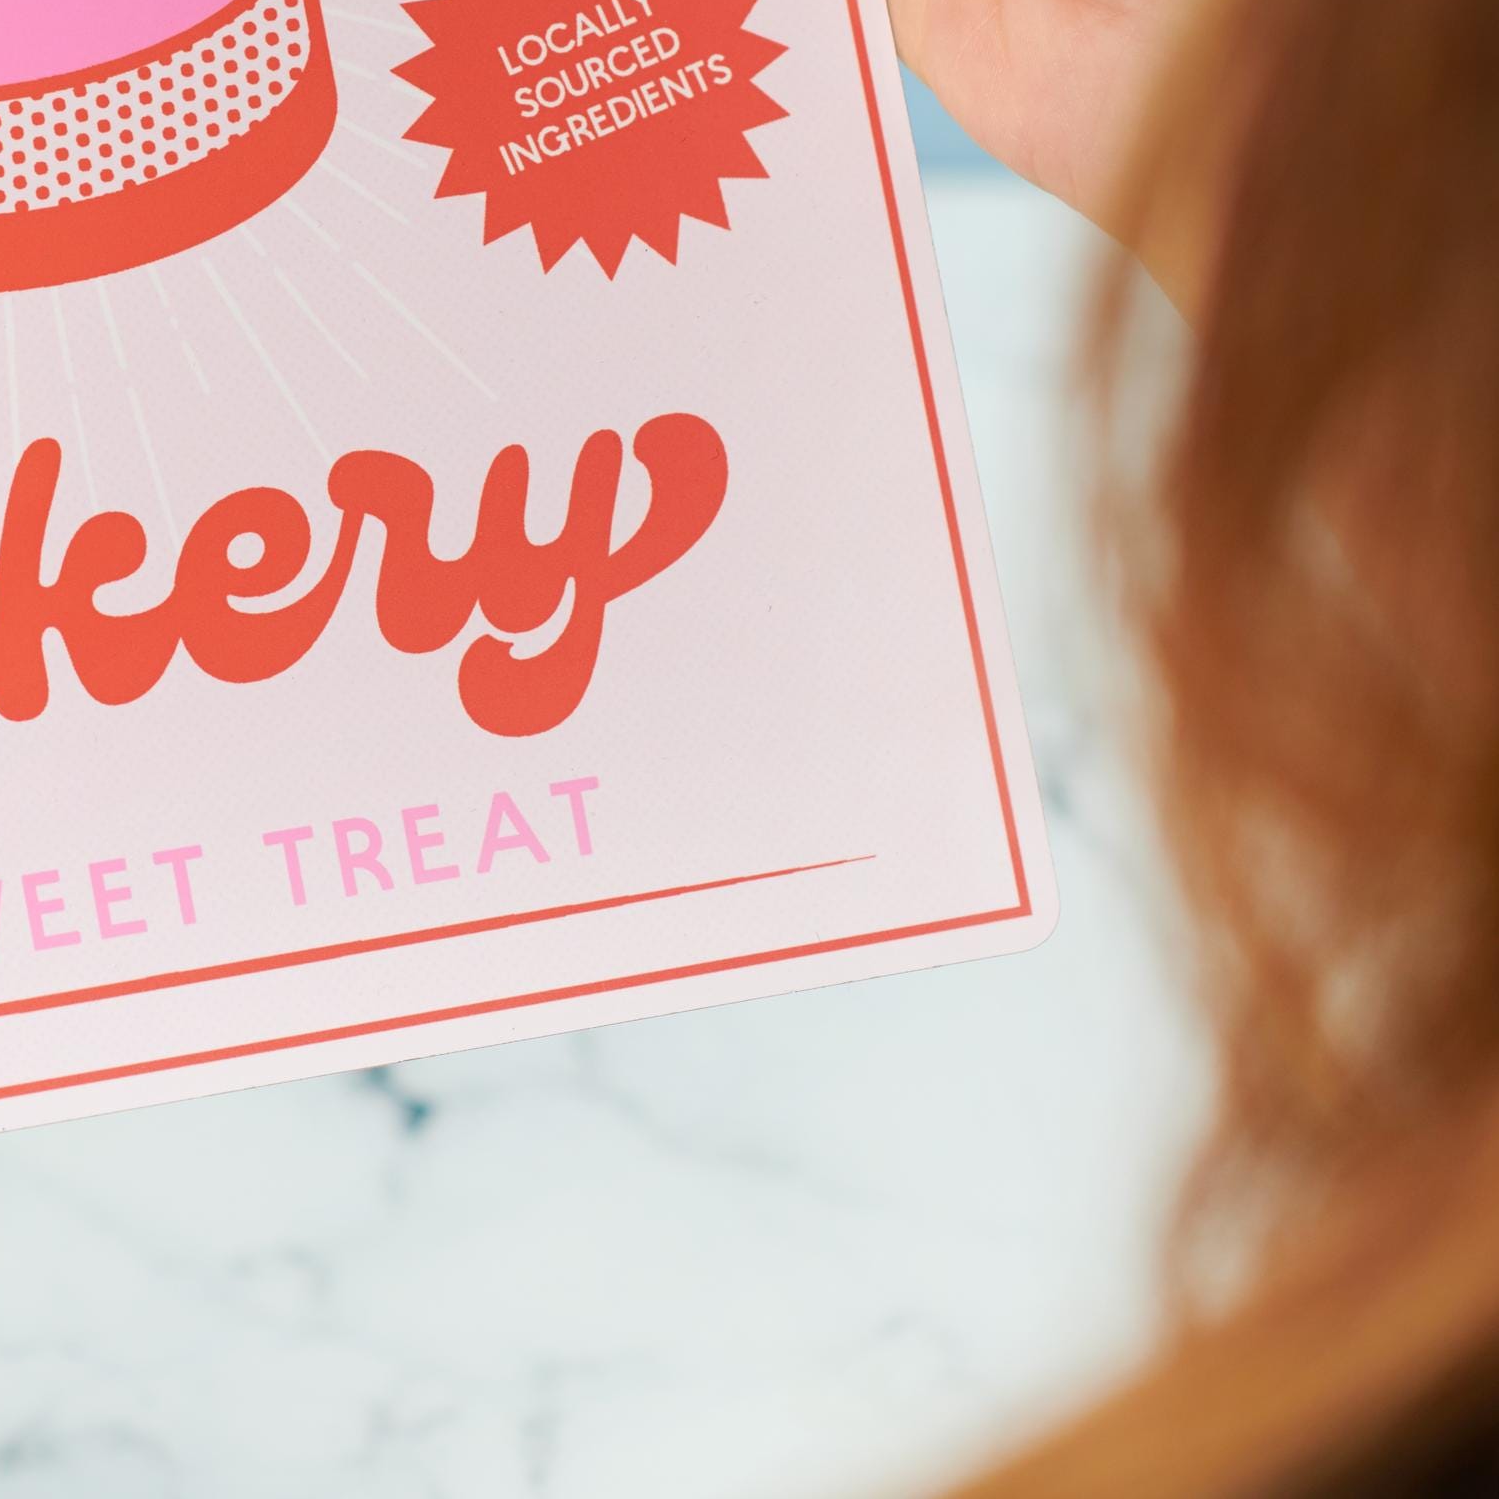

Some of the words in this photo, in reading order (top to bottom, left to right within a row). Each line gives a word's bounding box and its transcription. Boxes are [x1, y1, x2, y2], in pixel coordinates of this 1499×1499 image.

[499, 53, 733, 176] INGREDIENTS
[514, 27, 680, 118] SOURCED
[263, 777, 599, 905] TREAT
